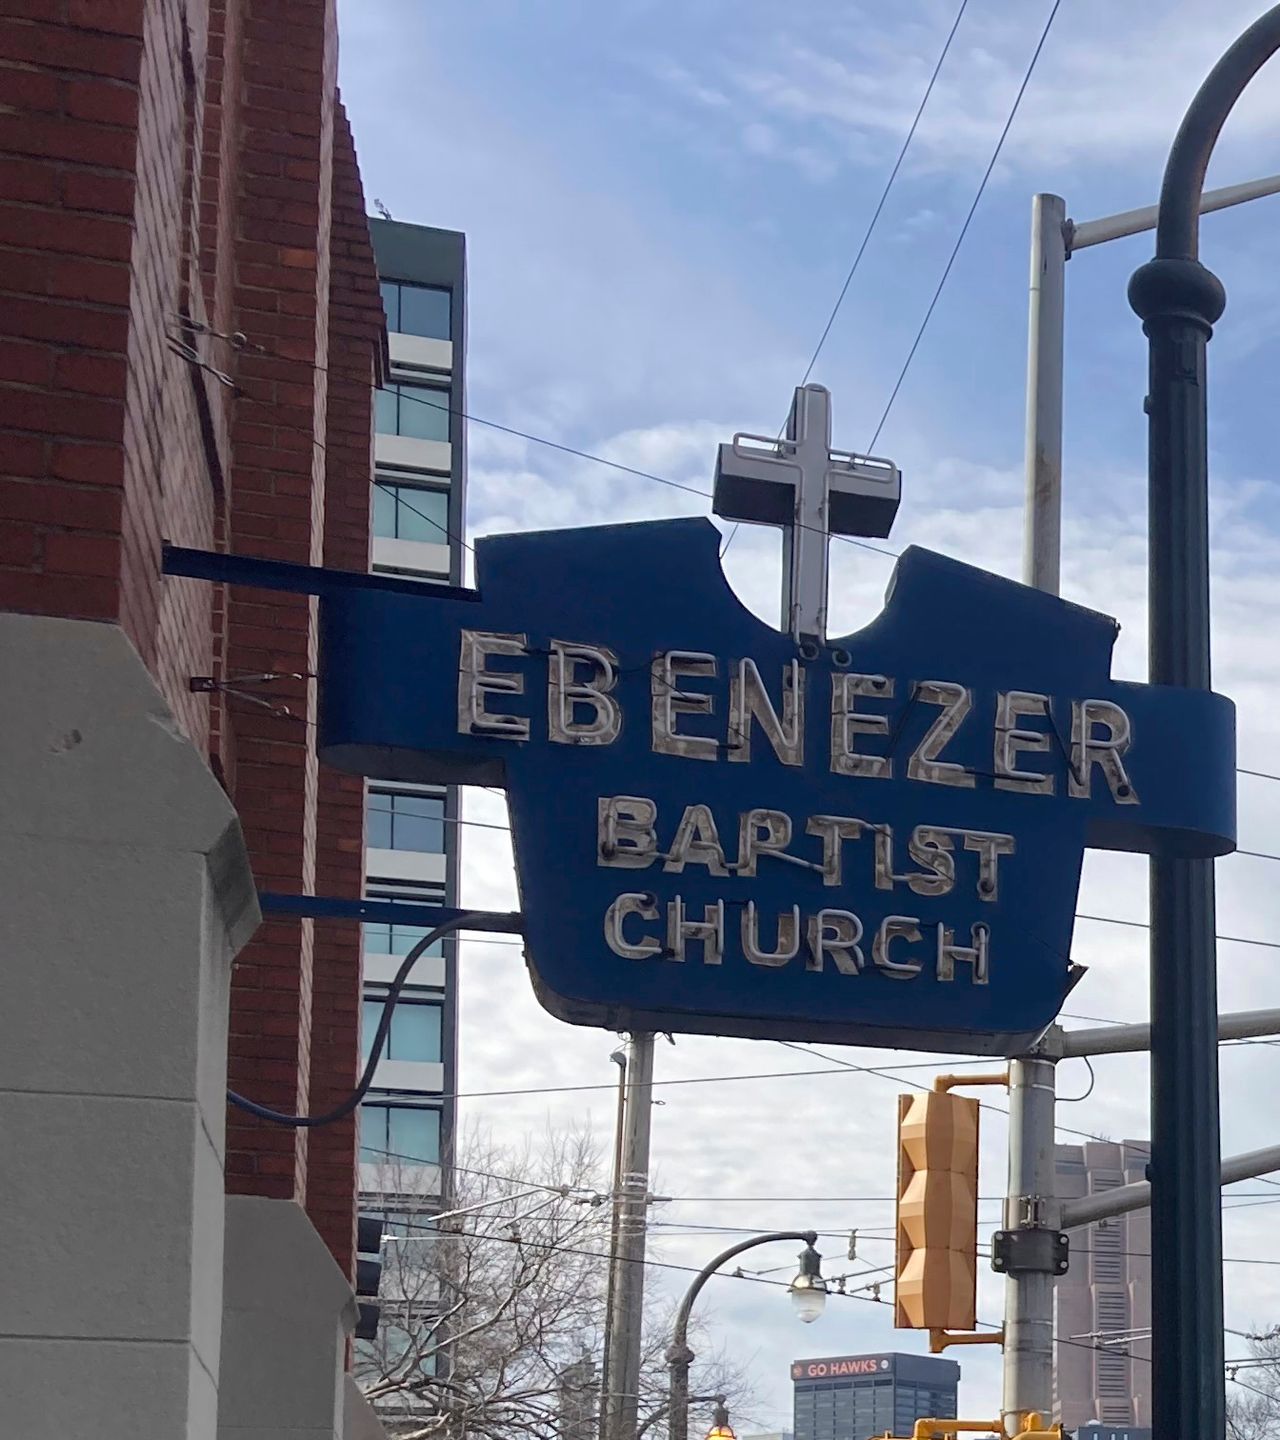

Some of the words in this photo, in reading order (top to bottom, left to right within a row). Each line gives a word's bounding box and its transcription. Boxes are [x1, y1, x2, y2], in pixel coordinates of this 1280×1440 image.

[457, 629, 1140, 805] EBENEZER
[596, 795, 1016, 902] BAPTIST
[603, 893, 991, 985] CHURCH
[808, 1363, 827, 1376] GO
[830, 1360, 877, 1375] HAWKS
